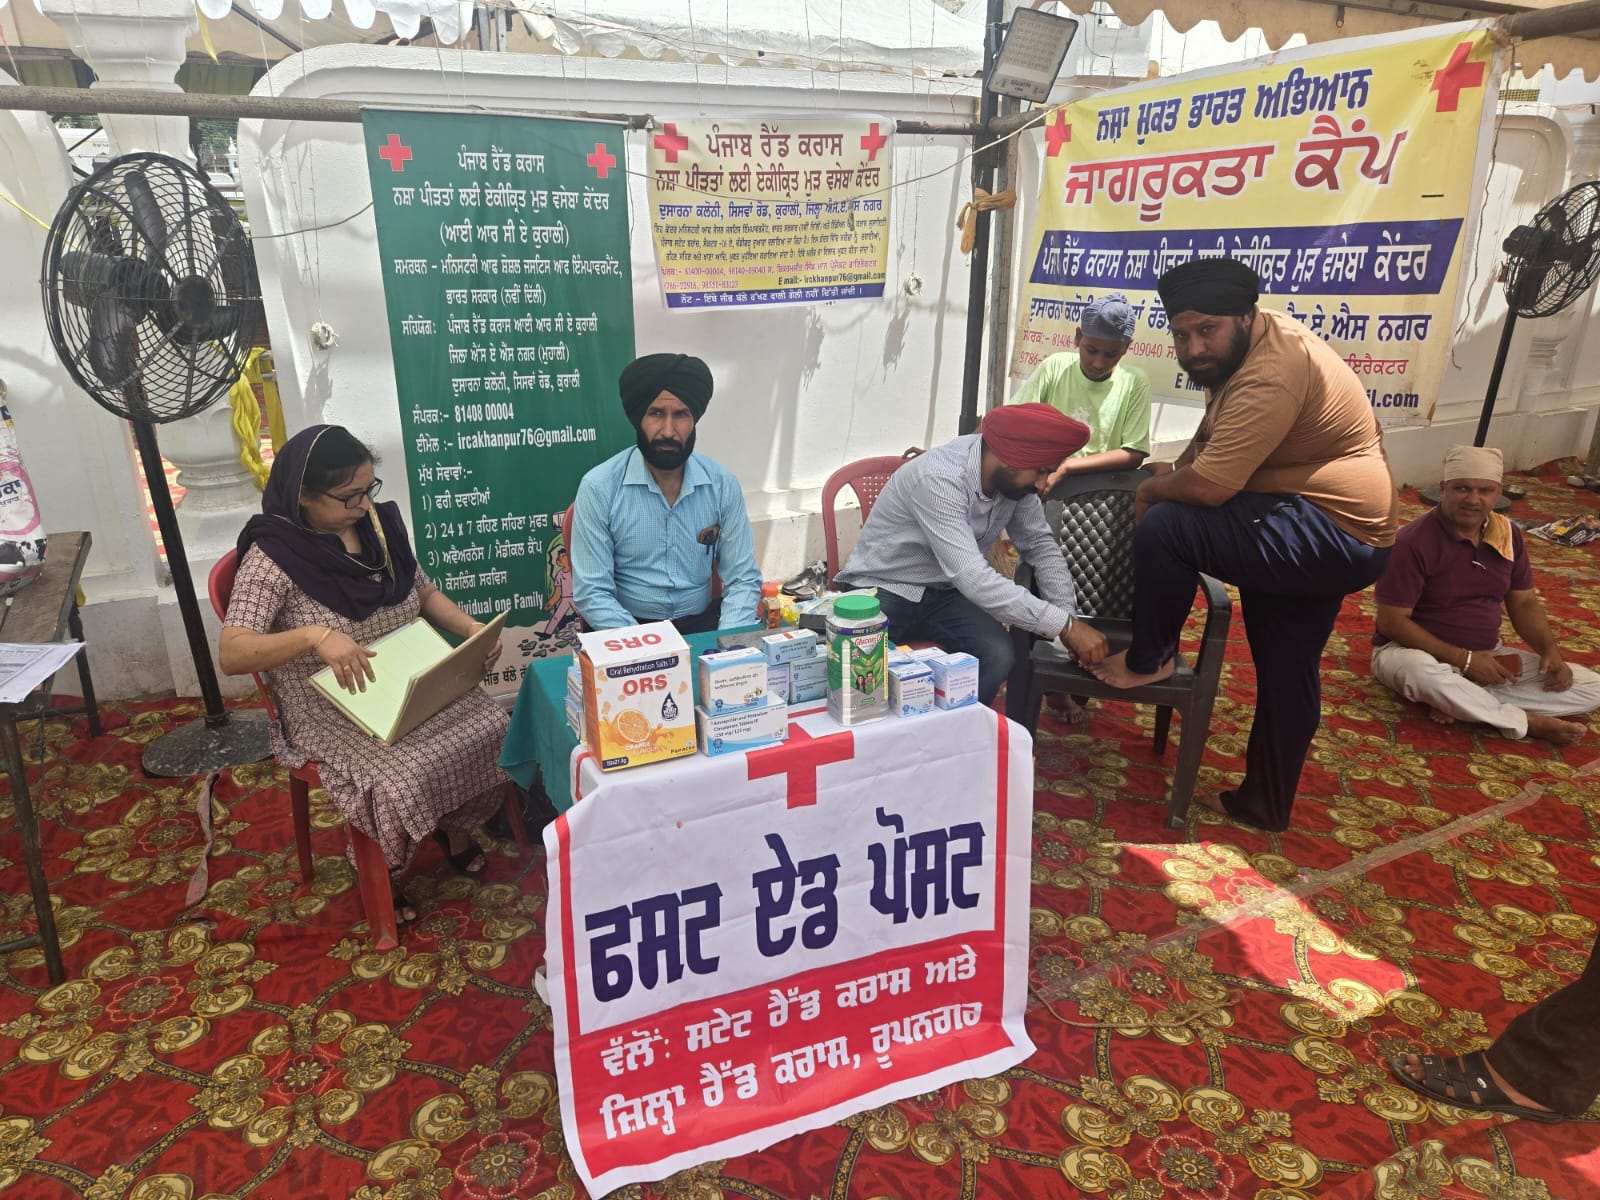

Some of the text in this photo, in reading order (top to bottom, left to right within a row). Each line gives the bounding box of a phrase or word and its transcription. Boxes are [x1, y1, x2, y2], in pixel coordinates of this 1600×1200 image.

[1096, 67, 1372, 145] ਨਸ਼ਾ ਮੁਕਤ ਭਾਰਤ ਅਭਿਆਨ
[706, 123, 843, 158] ਪੰਜਾਬ ਰੈੱਡ ਕਰਾਸ
[458, 144, 544, 173] ਪੰਜਾਬ ਰੈੱਡ ਕਰਾਸ
[1064, 115, 1408, 222] ਜਾਗਰੂਕਤਾ ਕੈਂਪ
[685, 163, 724, 192] ਪੀੜਤਾਂ
[729, 163, 751, 192] ਲਈ
[756, 163, 799, 198] ਏਕੀਕ੍ਰਿਤ
[804, 171, 822, 197] ਮੁੜ
[826, 162, 854, 190] ਵਸੇਬਾ
[856, 161, 880, 188] ਕੇਂਦਰ
[419, 180, 454, 206] ਪੀੜਤਾਂ
[458, 181, 480, 207] ਲਈ
[484, 182, 527, 213] ਏਕੀਕ੍ਰਿਤ
[530, 190, 548, 213] ਮੁੜ
[552, 185, 579, 210] ਵਸੇਬਾ
[583, 185, 610, 210] ਕੇਂਦਰ
[863, 200, 882, 212] ਨਗਰ
[476, 225, 498, 243] ਆਰ
[502, 218, 515, 243] ਸੀ
[519, 219, 528, 243] ਏ
[532, 220, 569, 249] ਕੁਰਾਲੀ)
[481, 259, 498, 274] ਆਫ
[554, 260, 569, 274] ਆਫ
[1063, 234, 1085, 277] ਰੈੱਡ
[1085, 249, 1123, 278] ਕਰਾਸ
[1291, 247, 1321, 293] ਮੁੜ
[1323, 232, 1368, 283] ਵਸੇਬਾ
[1374, 230, 1432, 283] ਕੇਂਦਰ
[445, 289, 467, 304] ਭਾਰਤ
[471, 289, 497, 304] ਸਰਕਾਰ
[447, 313, 470, 334] ਪੰਜਾਬ
[472, 312, 486, 334] ਰੈੱਡ
[489, 319, 511, 333] ਕਰਾਸ
[514, 312, 533, 333] ਆਈ
[535, 318, 551, 333] ਆਰ
[554, 312, 564, 332] ਸੀ
[566, 312, 573, 332] ਏ
[575, 312, 598, 336] ਕੁਰਾਲੀ
[1378, 314, 1432, 341] ਨਗਰ
[489, 342, 496, 362] ਏ
[517, 347, 535, 362] ਨਗਰ
[513, 370, 535, 390] ਸਿਸਵਾਂ
[556, 368, 580, 392] ਕੁਰਾਲੀ
[454, 404, 483, 423] 81408
[485, 402, 514, 421] 00004
[457, 427, 596, 450] ircakhanpur76@gmail.com
[422, 487, 491, 512] 1) ਫਰੀ ਦਵਾਈਆਂ
[425, 522, 437, 540] 2)
[441, 522, 454, 538] 24
[467, 521, 472, 535] 7
[476, 515, 498, 533] ਰਹਿਣ
[529, 513, 548, 532] ਮੁਫਤ
[428, 550, 439, 568] 3)
[495, 539, 525, 558] ਮੈਡੀਕਲ
[479, 567, 507, 586] ਸਰਵਿਸ
[495, 598, 511, 613] one
[514, 591, 543, 610] Family
[604, 633, 662, 651] ORS
[623, 674, 667, 696] ORS
[585, 806, 986, 1002] ਫਸਟ ਏਡ ਪੋਸਟ
[685, 1007, 752, 1052] ਸਟੇਟ
[835, 967, 911, 1008] ਕਰਾਸ
[925, 944, 978, 985] ਅਤੇ
[771, 1036, 860, 1084] ਕਰਾਸ,
[870, 1001, 983, 1069] ਰੂਪਨਗਰ
